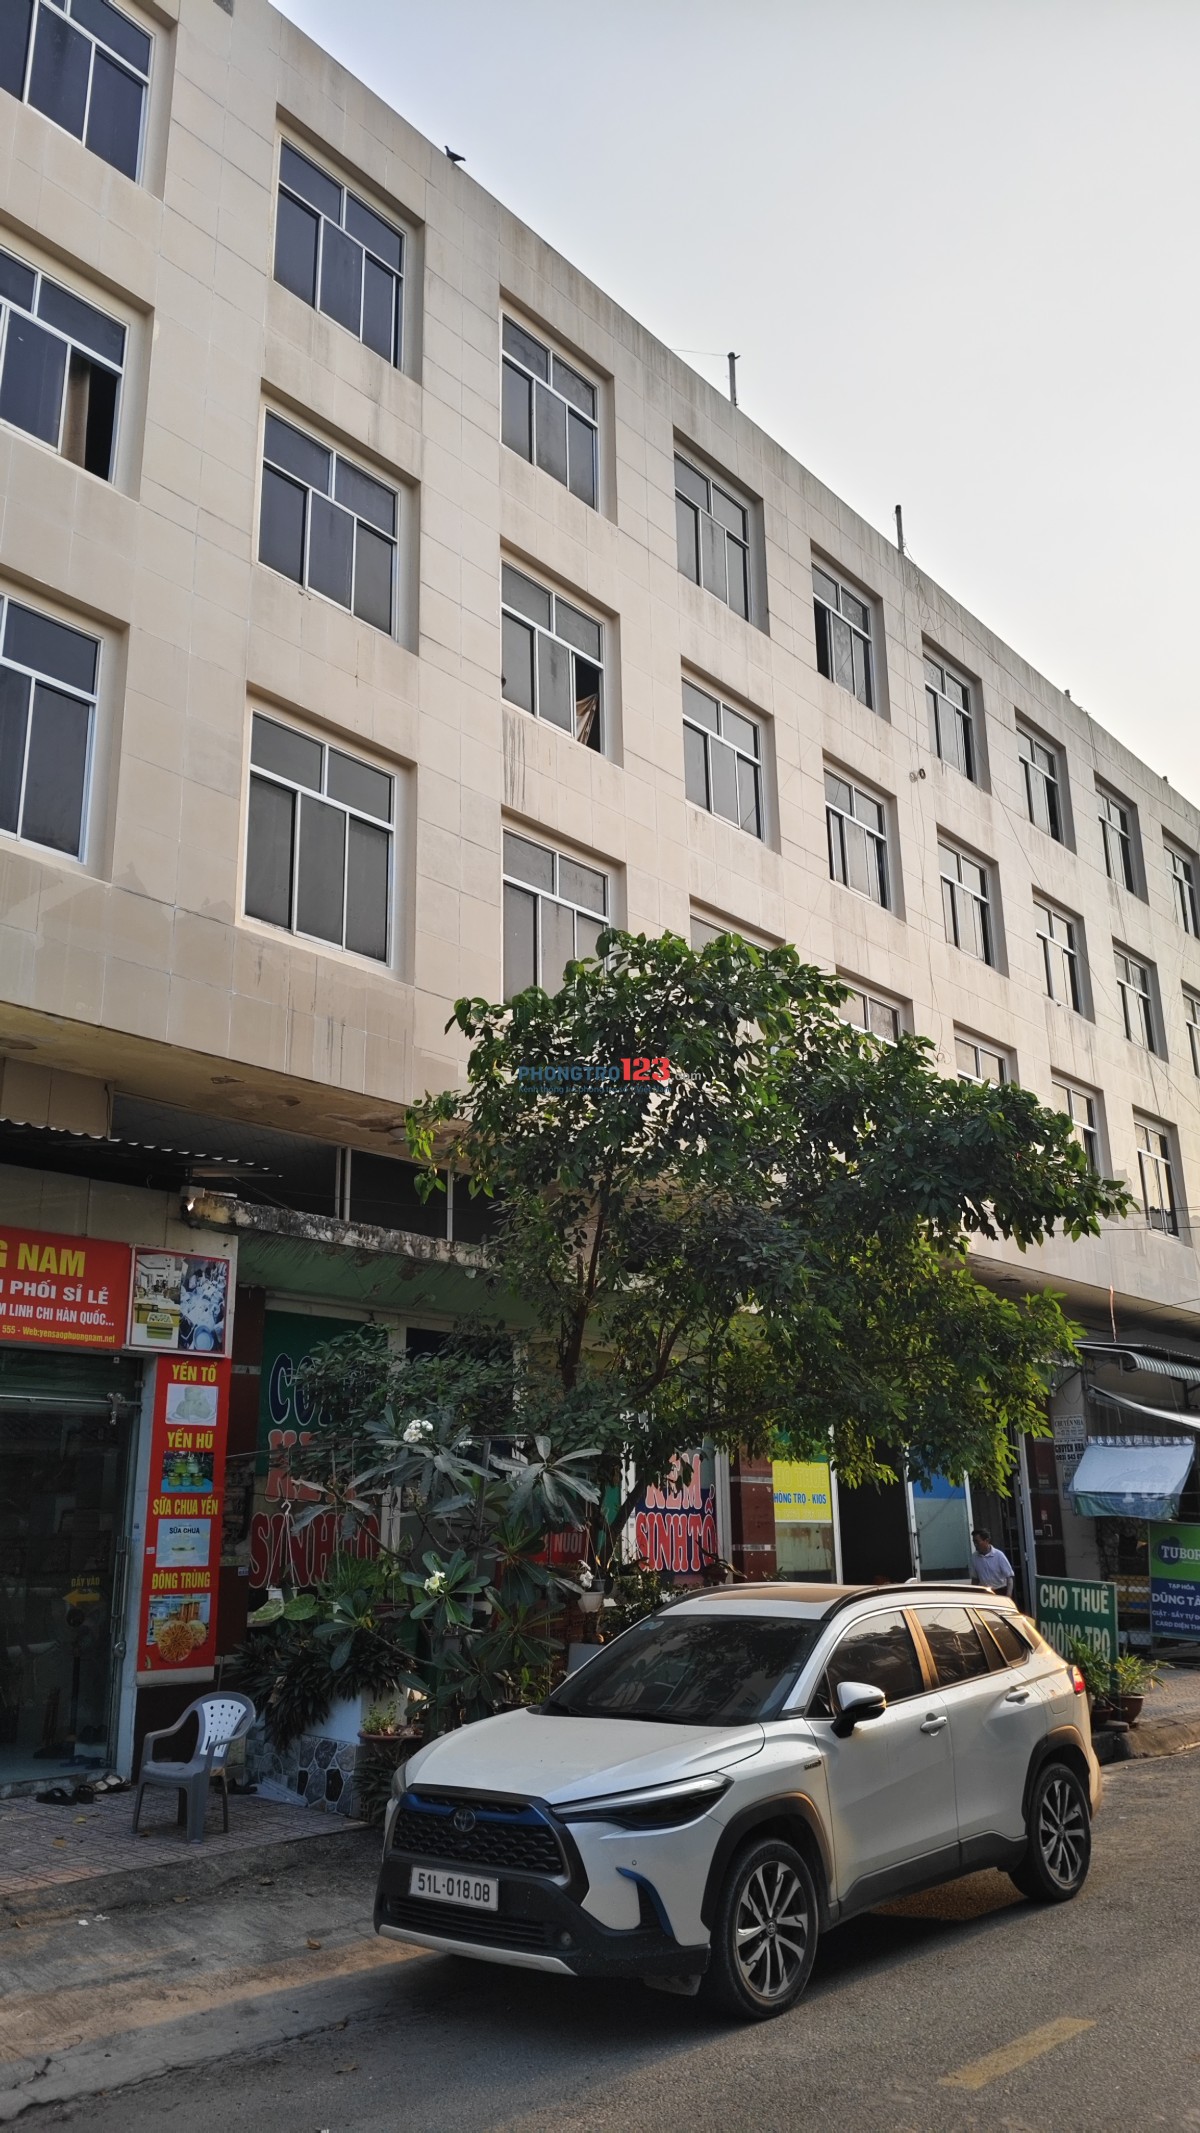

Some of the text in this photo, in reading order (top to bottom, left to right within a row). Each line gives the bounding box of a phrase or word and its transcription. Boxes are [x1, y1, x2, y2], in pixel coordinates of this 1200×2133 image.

[17, 1242, 86, 1278] NAM
[9, 1279, 57, 1299] PHỐI
[62, 1283, 83, 1303] SỈ
[87, 1286, 110, 1305] LẺ
[9, 1303, 34, 1318] LINH
[36, 1306, 54, 1320] CHI
[56, 1307, 78, 1323] HÀN
[172, 1361, 218, 1383] YẾN TỔ
[167, 1427, 214, 1449] YẾN HŨ
[153, 1494, 219, 1516] SỮA CHUA YẾN
[772, 1490, 792, 1504] HÒNG
[812, 1493, 827, 1504] KIOS
[1040, 1584, 1110, 1615] CHO THUÊ
[1152, 1592, 1186, 1606] DŨNG
